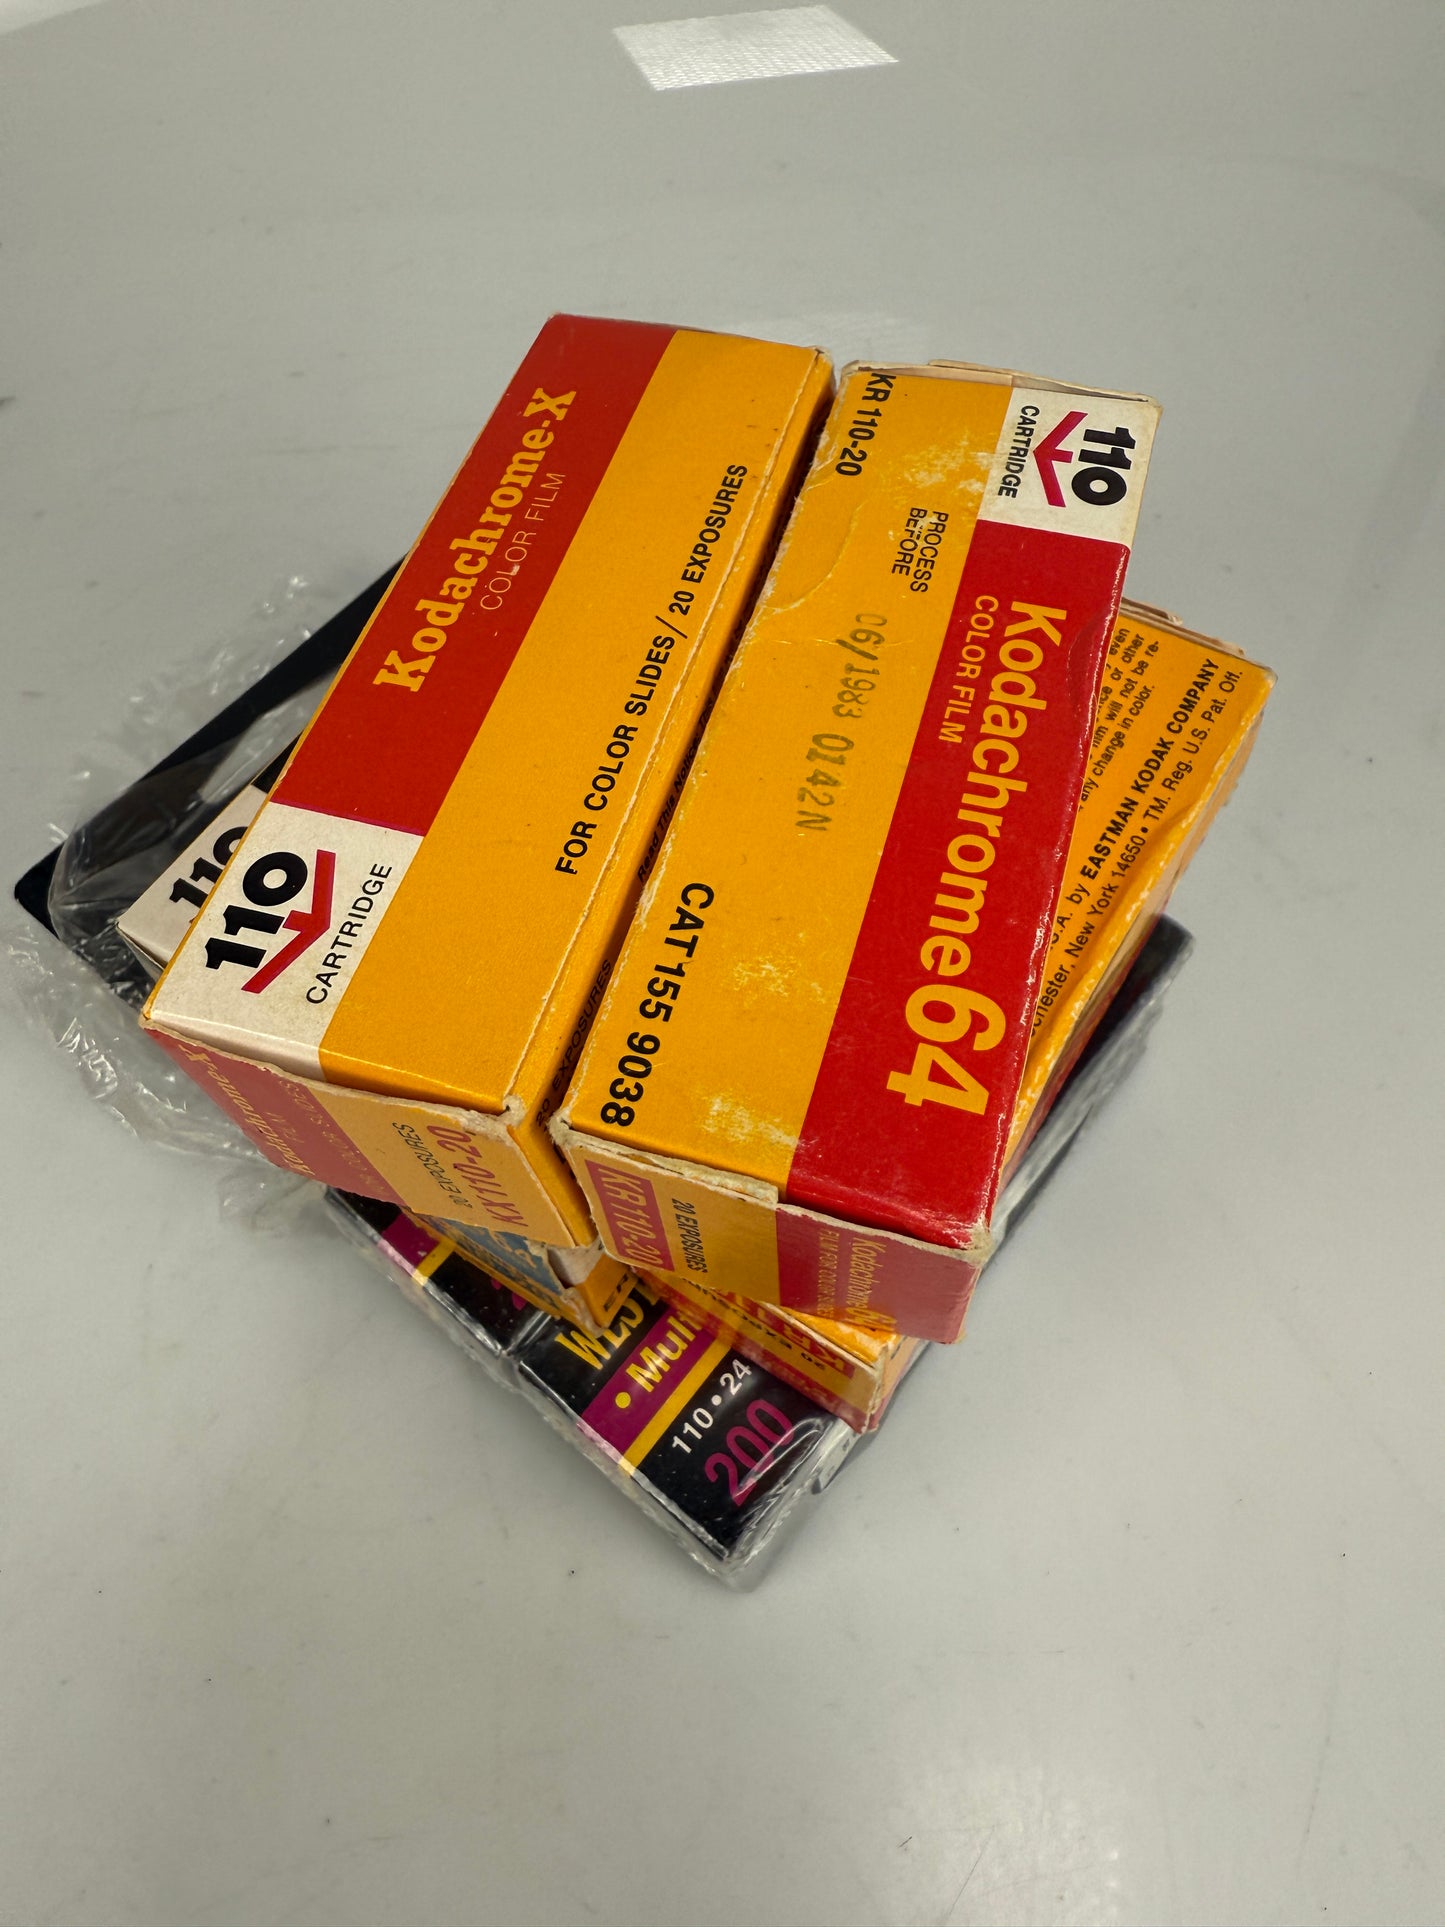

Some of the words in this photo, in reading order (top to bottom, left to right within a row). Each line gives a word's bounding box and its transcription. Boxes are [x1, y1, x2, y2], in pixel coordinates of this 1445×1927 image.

[861, 372, 897, 402] KR
[834, 407, 883, 477] 110-20
[996, 404, 1041, 499] CARTRIDGE
[1070, 425, 1137, 507] 110
[372, 387, 578, 693] Kodachrome-X
[479, 529, 537, 611] COLOR
[524, 472, 567, 522] FILM
[680, 463, 749, 584] EXPOSURES
[891, 506, 928, 577] BEFORE
[909, 510, 950, 593] PROCESS
[668, 589, 695, 617] 20
[955, 594, 1000, 679] COLOR
[832, 612, 888, 720] 06/1983
[1105, 700, 1123, 722] will
[1119, 677, 1139, 699] not
[1129, 660, 1150, 676] be
[1144, 640, 1160, 657] re-
[1110, 666, 1124, 681] or
[1121, 633, 1145, 664] other
[938, 684, 976, 744] FILM
[1080, 777, 1100, 803] any
[1092, 730, 1126, 777] change
[1116, 716, 1135, 731] in
[1128, 684, 1156, 717] color.
[582, 723, 640, 812] COLOR
[1065, 883, 1091, 905] by
[1080, 796, 1139, 880] EASTMAN
[1130, 736, 1175, 795] KODAK
[1166, 657, 1221, 735] COMPANY
[553, 820, 598, 876] FOR
[1064, 921, 1096, 958] New
[1087, 882, 1119, 917] York
[1110, 834, 1146, 879] 14650
[1142, 795, 1172, 822] TM.
[1161, 758, 1193, 792] Reg.
[1182, 726, 1212, 756] U.S.
[1200, 697, 1228, 724] Pat.
[204, 851, 309, 970] 110
[305, 863, 393, 1005] CARTRIDGE
[535, 1098, 551, 1128] 20
[551, 958, 612, 1092] EXPOSURES
[600, 1030, 661, 1128] 9038
[391, 1121, 462, 1195] EXPOSURES
[671, 1197, 697, 1216] 20
[674, 1213, 709, 1274] EXPOSURES
[671, 1407, 714, 1454] 110
[719, 1358, 753, 1397] 24
[703, 1399, 794, 1507] 200
